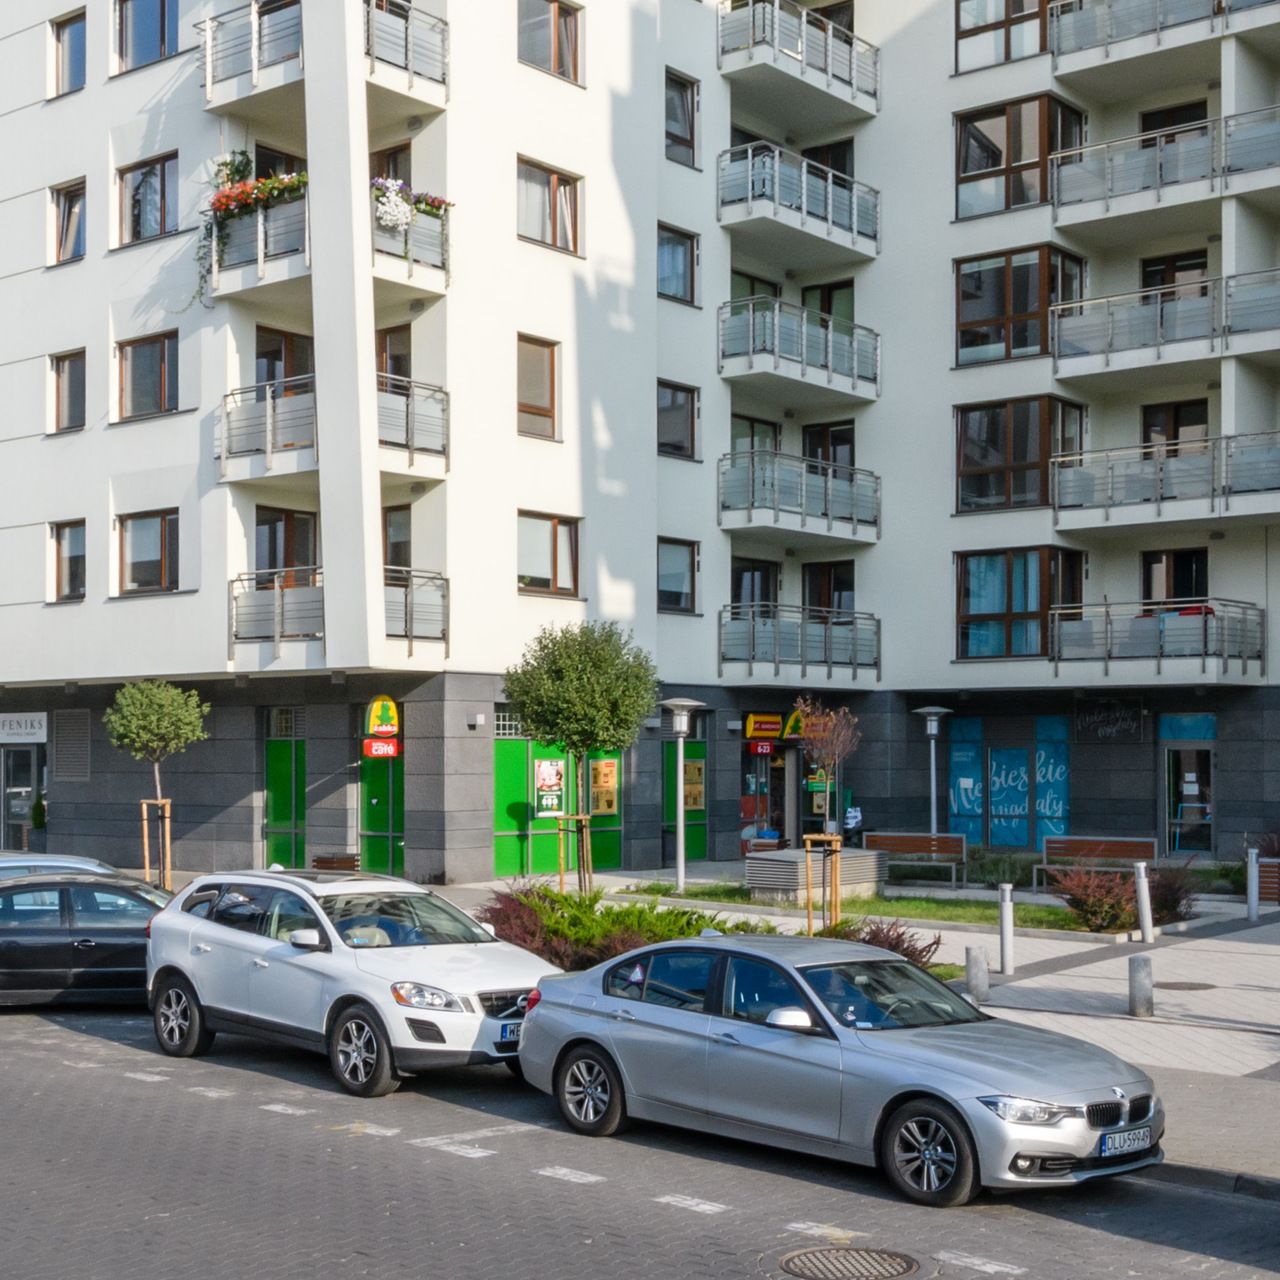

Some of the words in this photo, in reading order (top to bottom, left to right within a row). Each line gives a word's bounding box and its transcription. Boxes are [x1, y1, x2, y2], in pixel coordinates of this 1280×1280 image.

[2, 719, 44, 731] FENIKS
[372, 742, 395, 756] café
[1106, 1133, 1126, 1152] DLU
